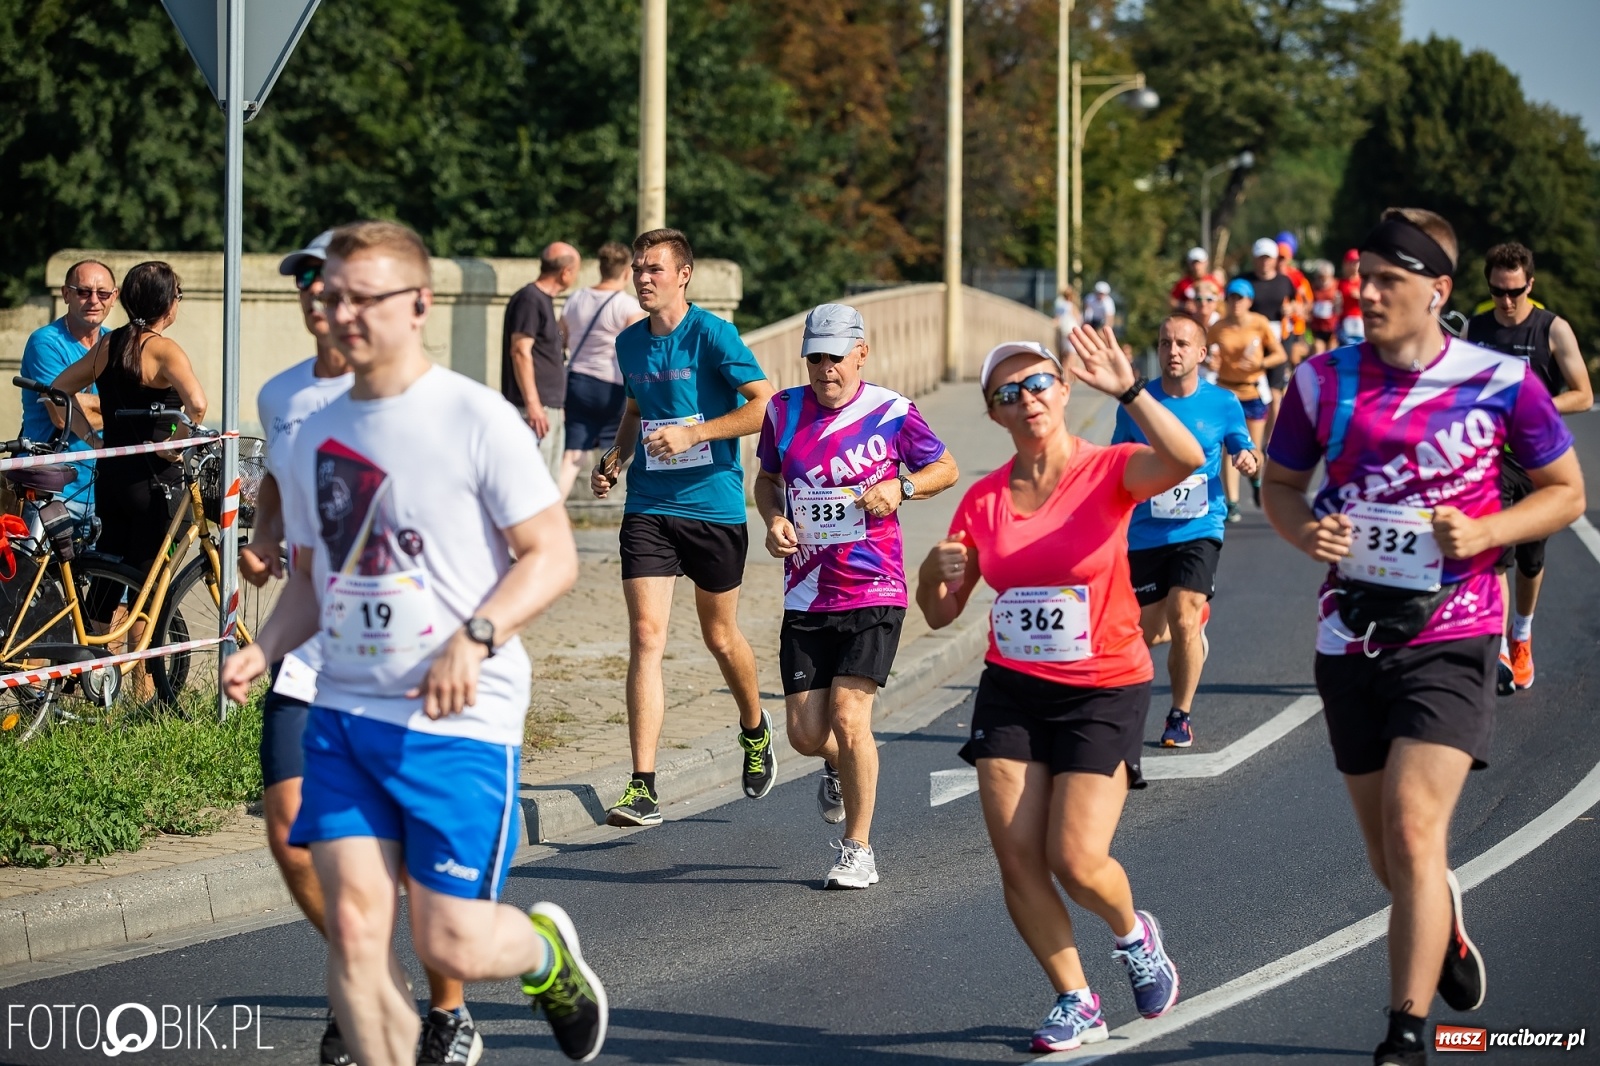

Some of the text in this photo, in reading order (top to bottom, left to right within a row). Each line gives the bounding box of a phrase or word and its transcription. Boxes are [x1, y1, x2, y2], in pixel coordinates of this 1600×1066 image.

[1173, 487, 1191, 501] 97
[811, 502, 846, 522] 333
[1367, 525, 1417, 555] 332
[361, 602, 392, 629] 19
[1020, 607, 1064, 631] 362
